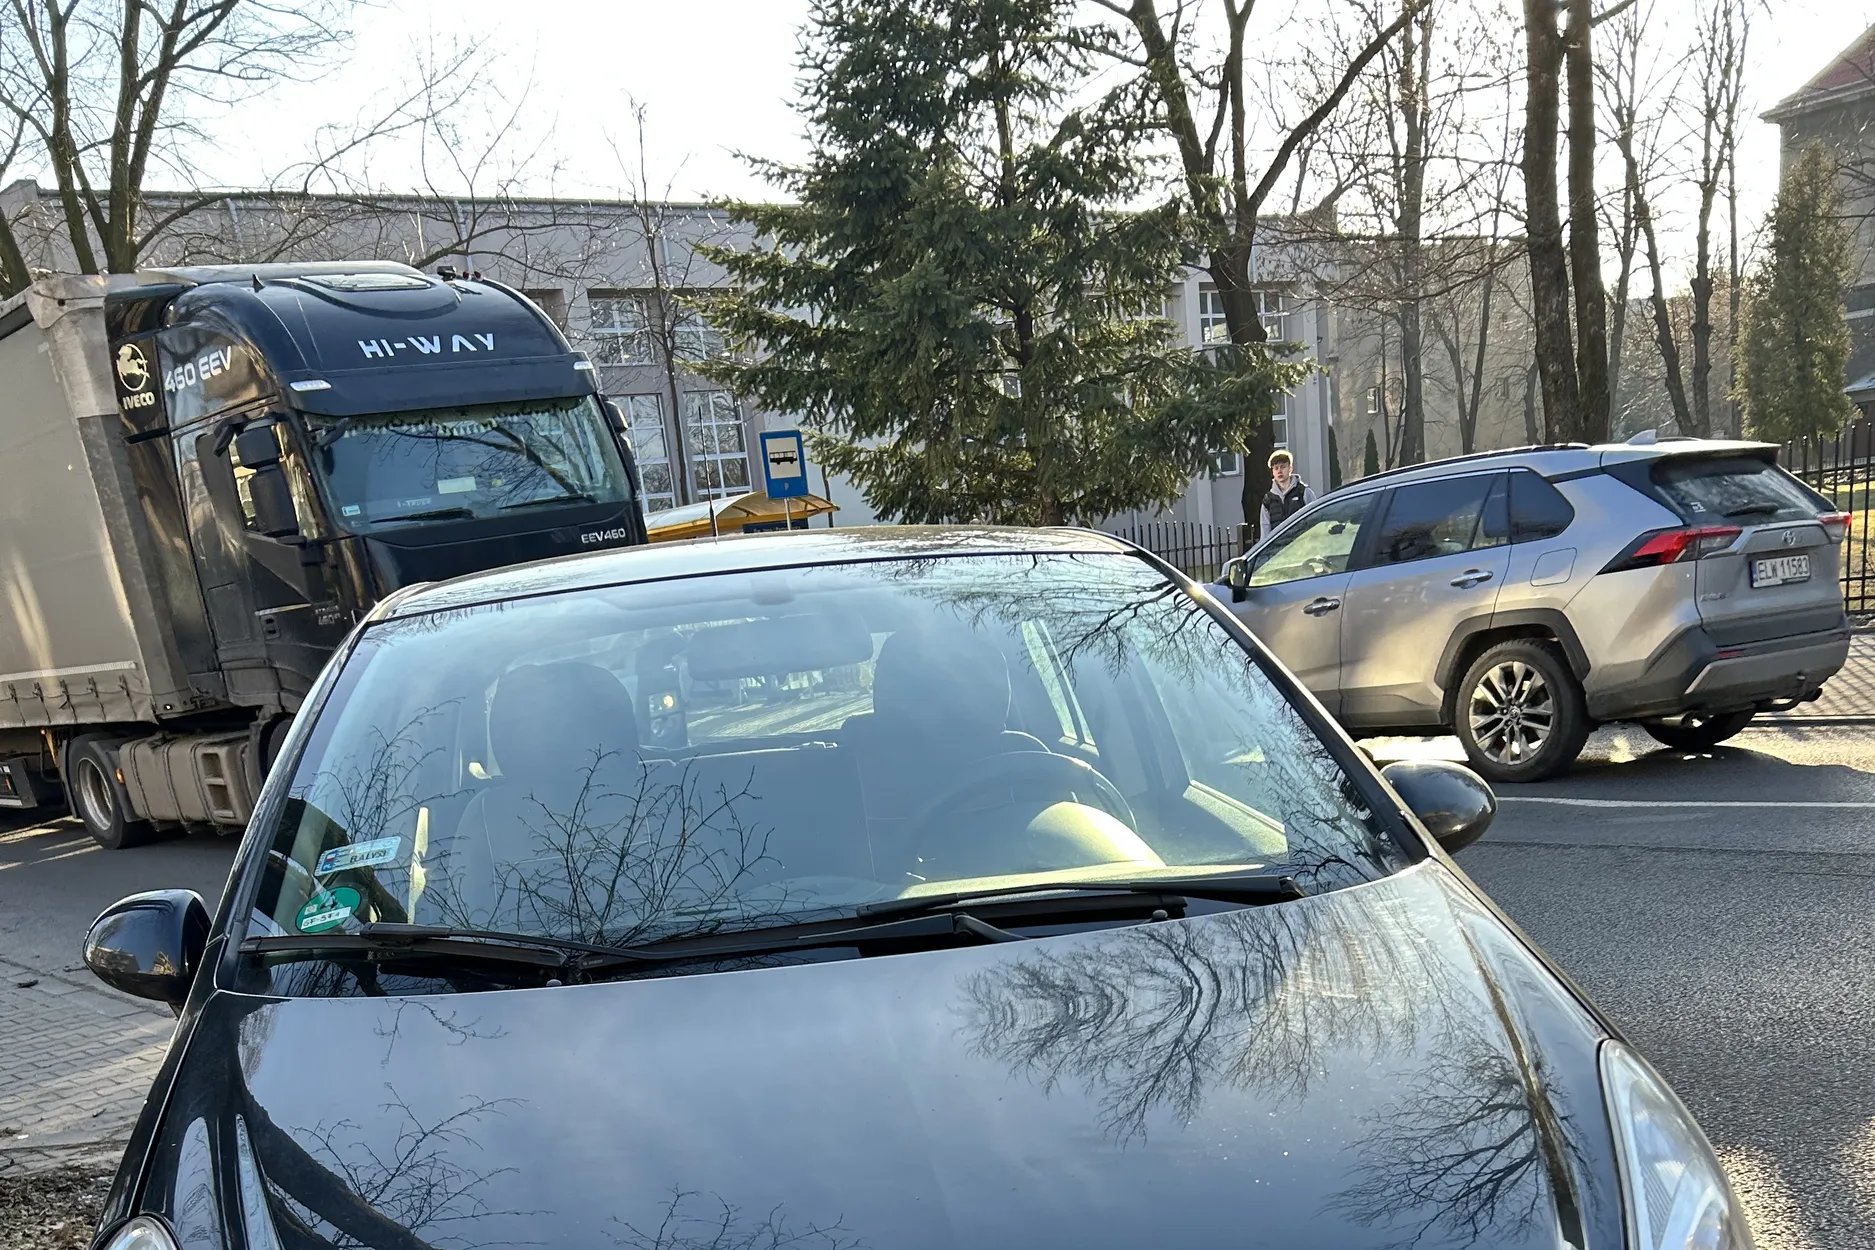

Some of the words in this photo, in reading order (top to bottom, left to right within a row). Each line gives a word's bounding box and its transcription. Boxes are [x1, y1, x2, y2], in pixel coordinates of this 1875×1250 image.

[358, 333, 494, 358] HI-WAY
[164, 362, 197, 392] 460
[199, 345, 232, 380] EEV
[122, 392, 156, 410] IVECO
